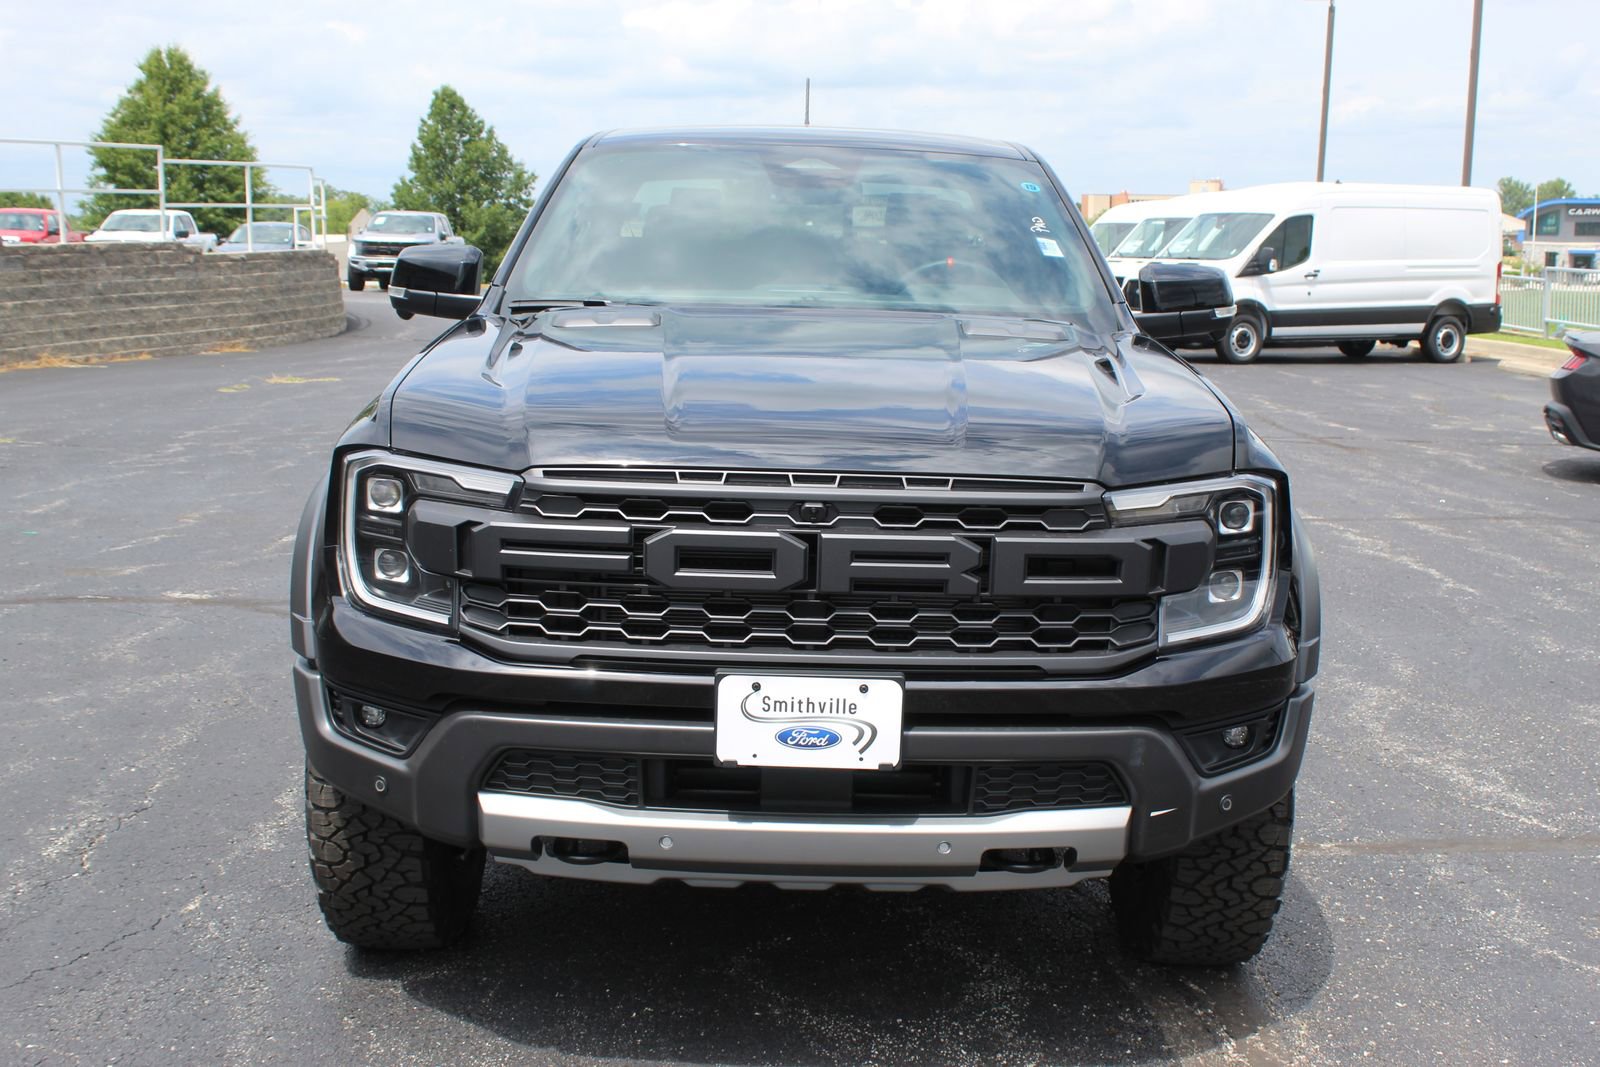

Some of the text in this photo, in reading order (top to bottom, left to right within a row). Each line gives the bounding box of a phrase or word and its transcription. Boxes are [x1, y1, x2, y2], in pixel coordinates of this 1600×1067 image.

[470, 521, 1152, 596] FORD
[762, 695, 858, 715] Smithville
[787, 728, 829, 747] Ford
